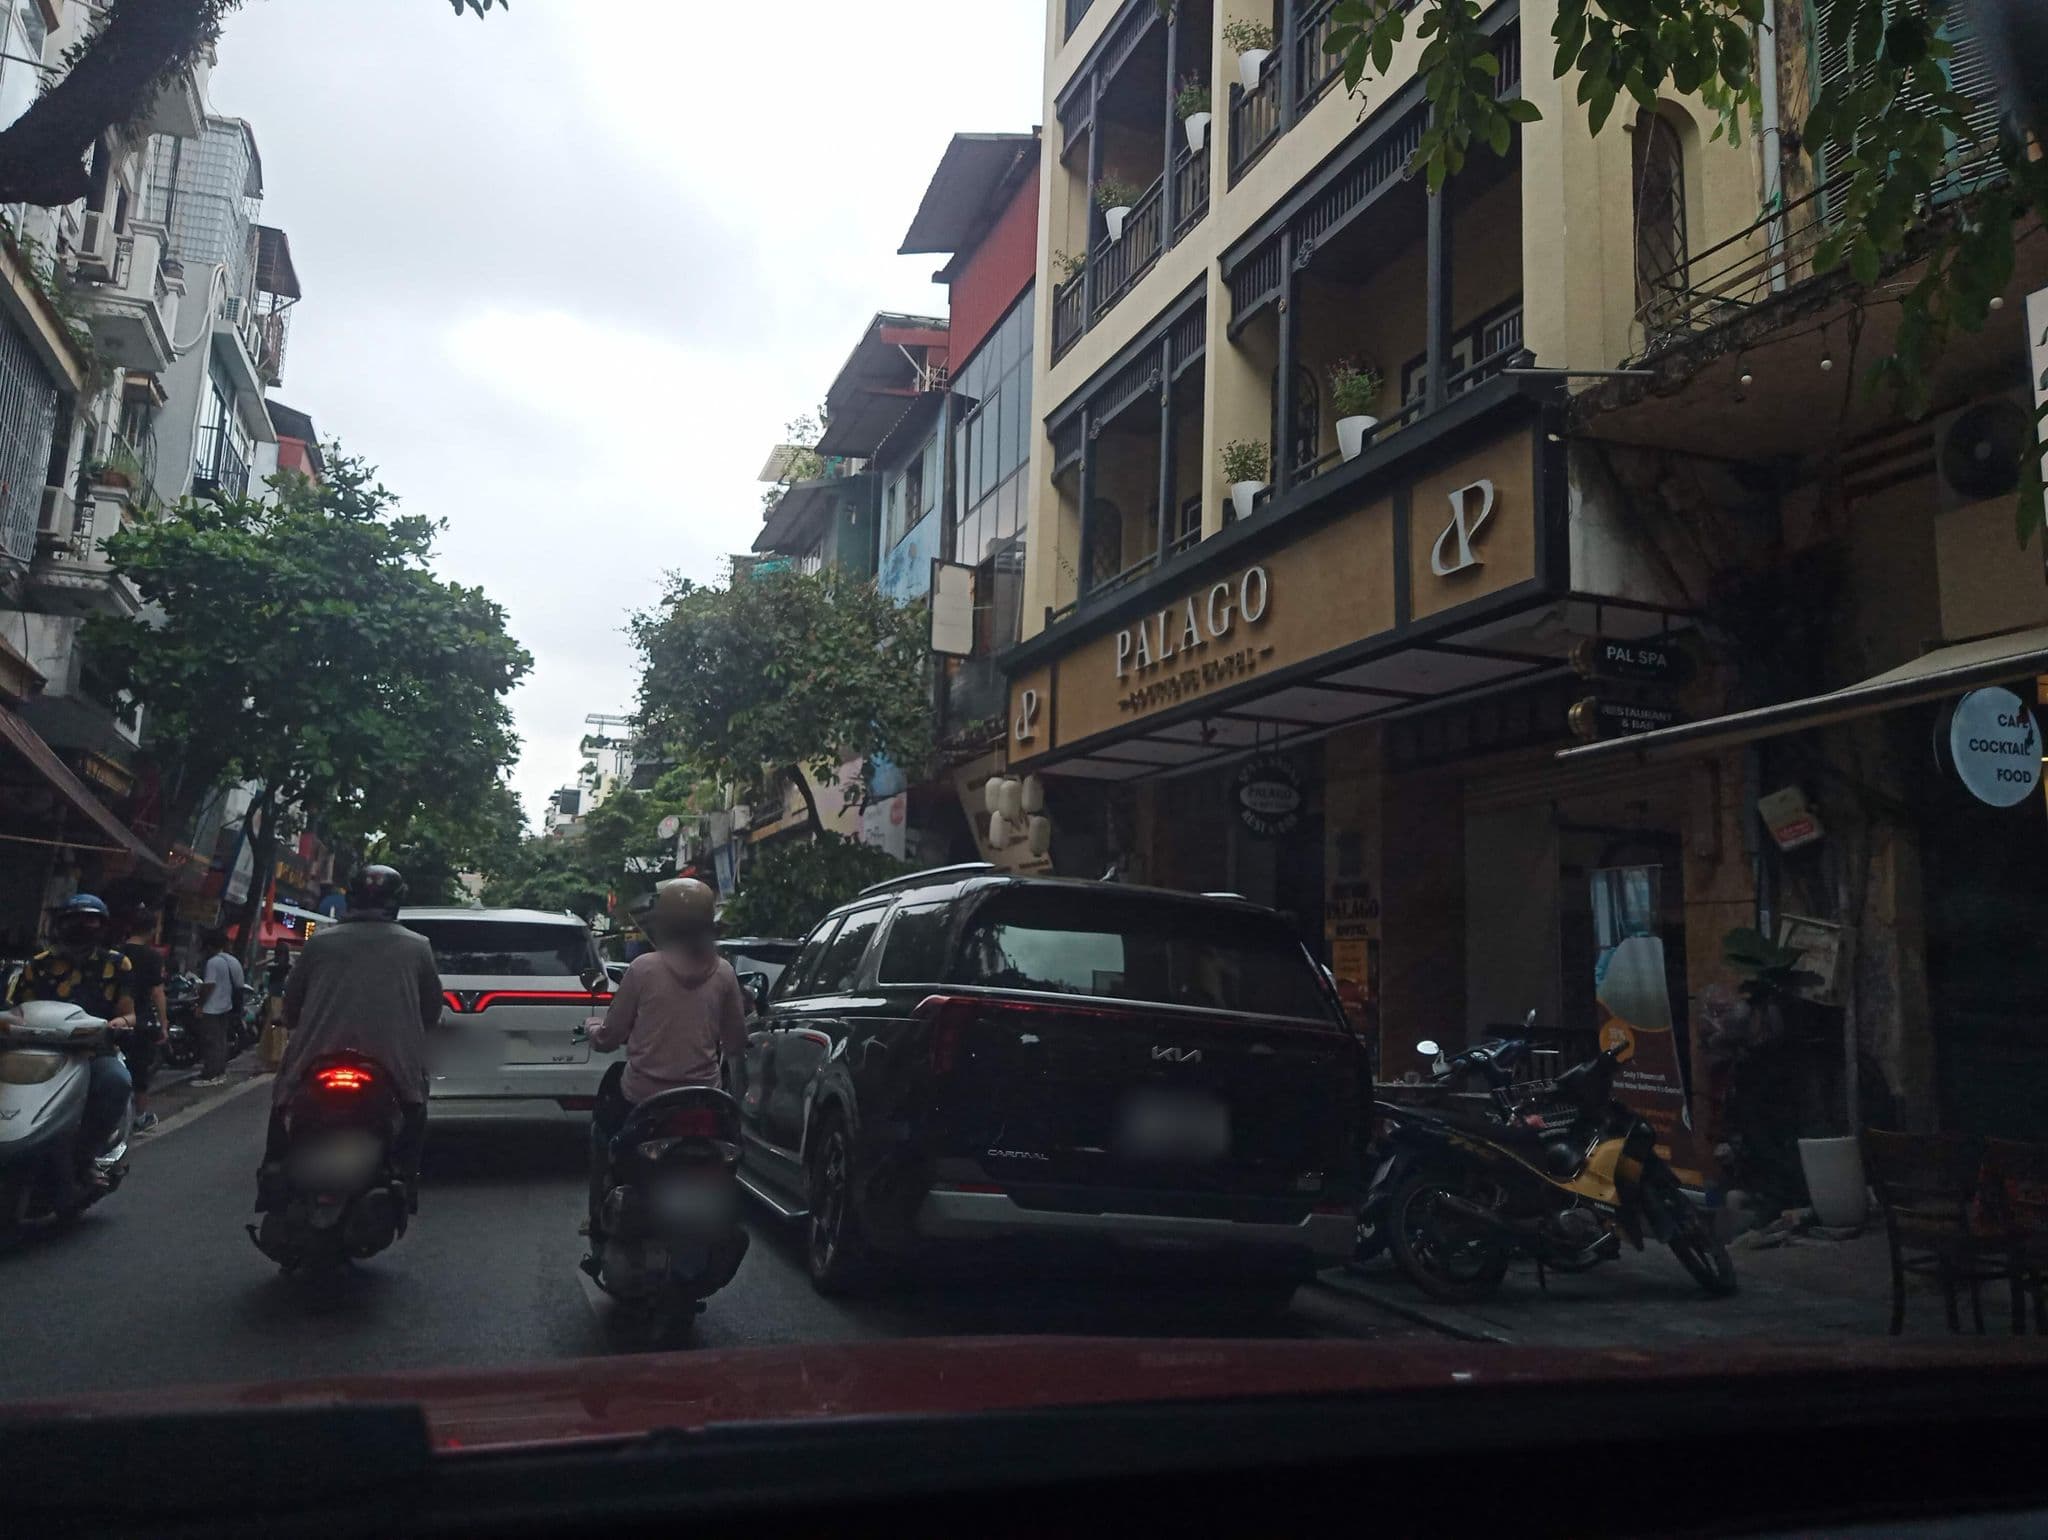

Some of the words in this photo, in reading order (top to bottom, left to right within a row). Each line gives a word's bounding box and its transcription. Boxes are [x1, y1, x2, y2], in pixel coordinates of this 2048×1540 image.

[1115, 565, 1267, 678] PALAGO
[1606, 645, 1634, 663] PAL
[1638, 650, 1667, 669] SPA
[1969, 738, 2030, 756] COCKTAIL
[1997, 768, 2031, 783] FOOD
[1151, 1045, 1202, 1063] KIA
